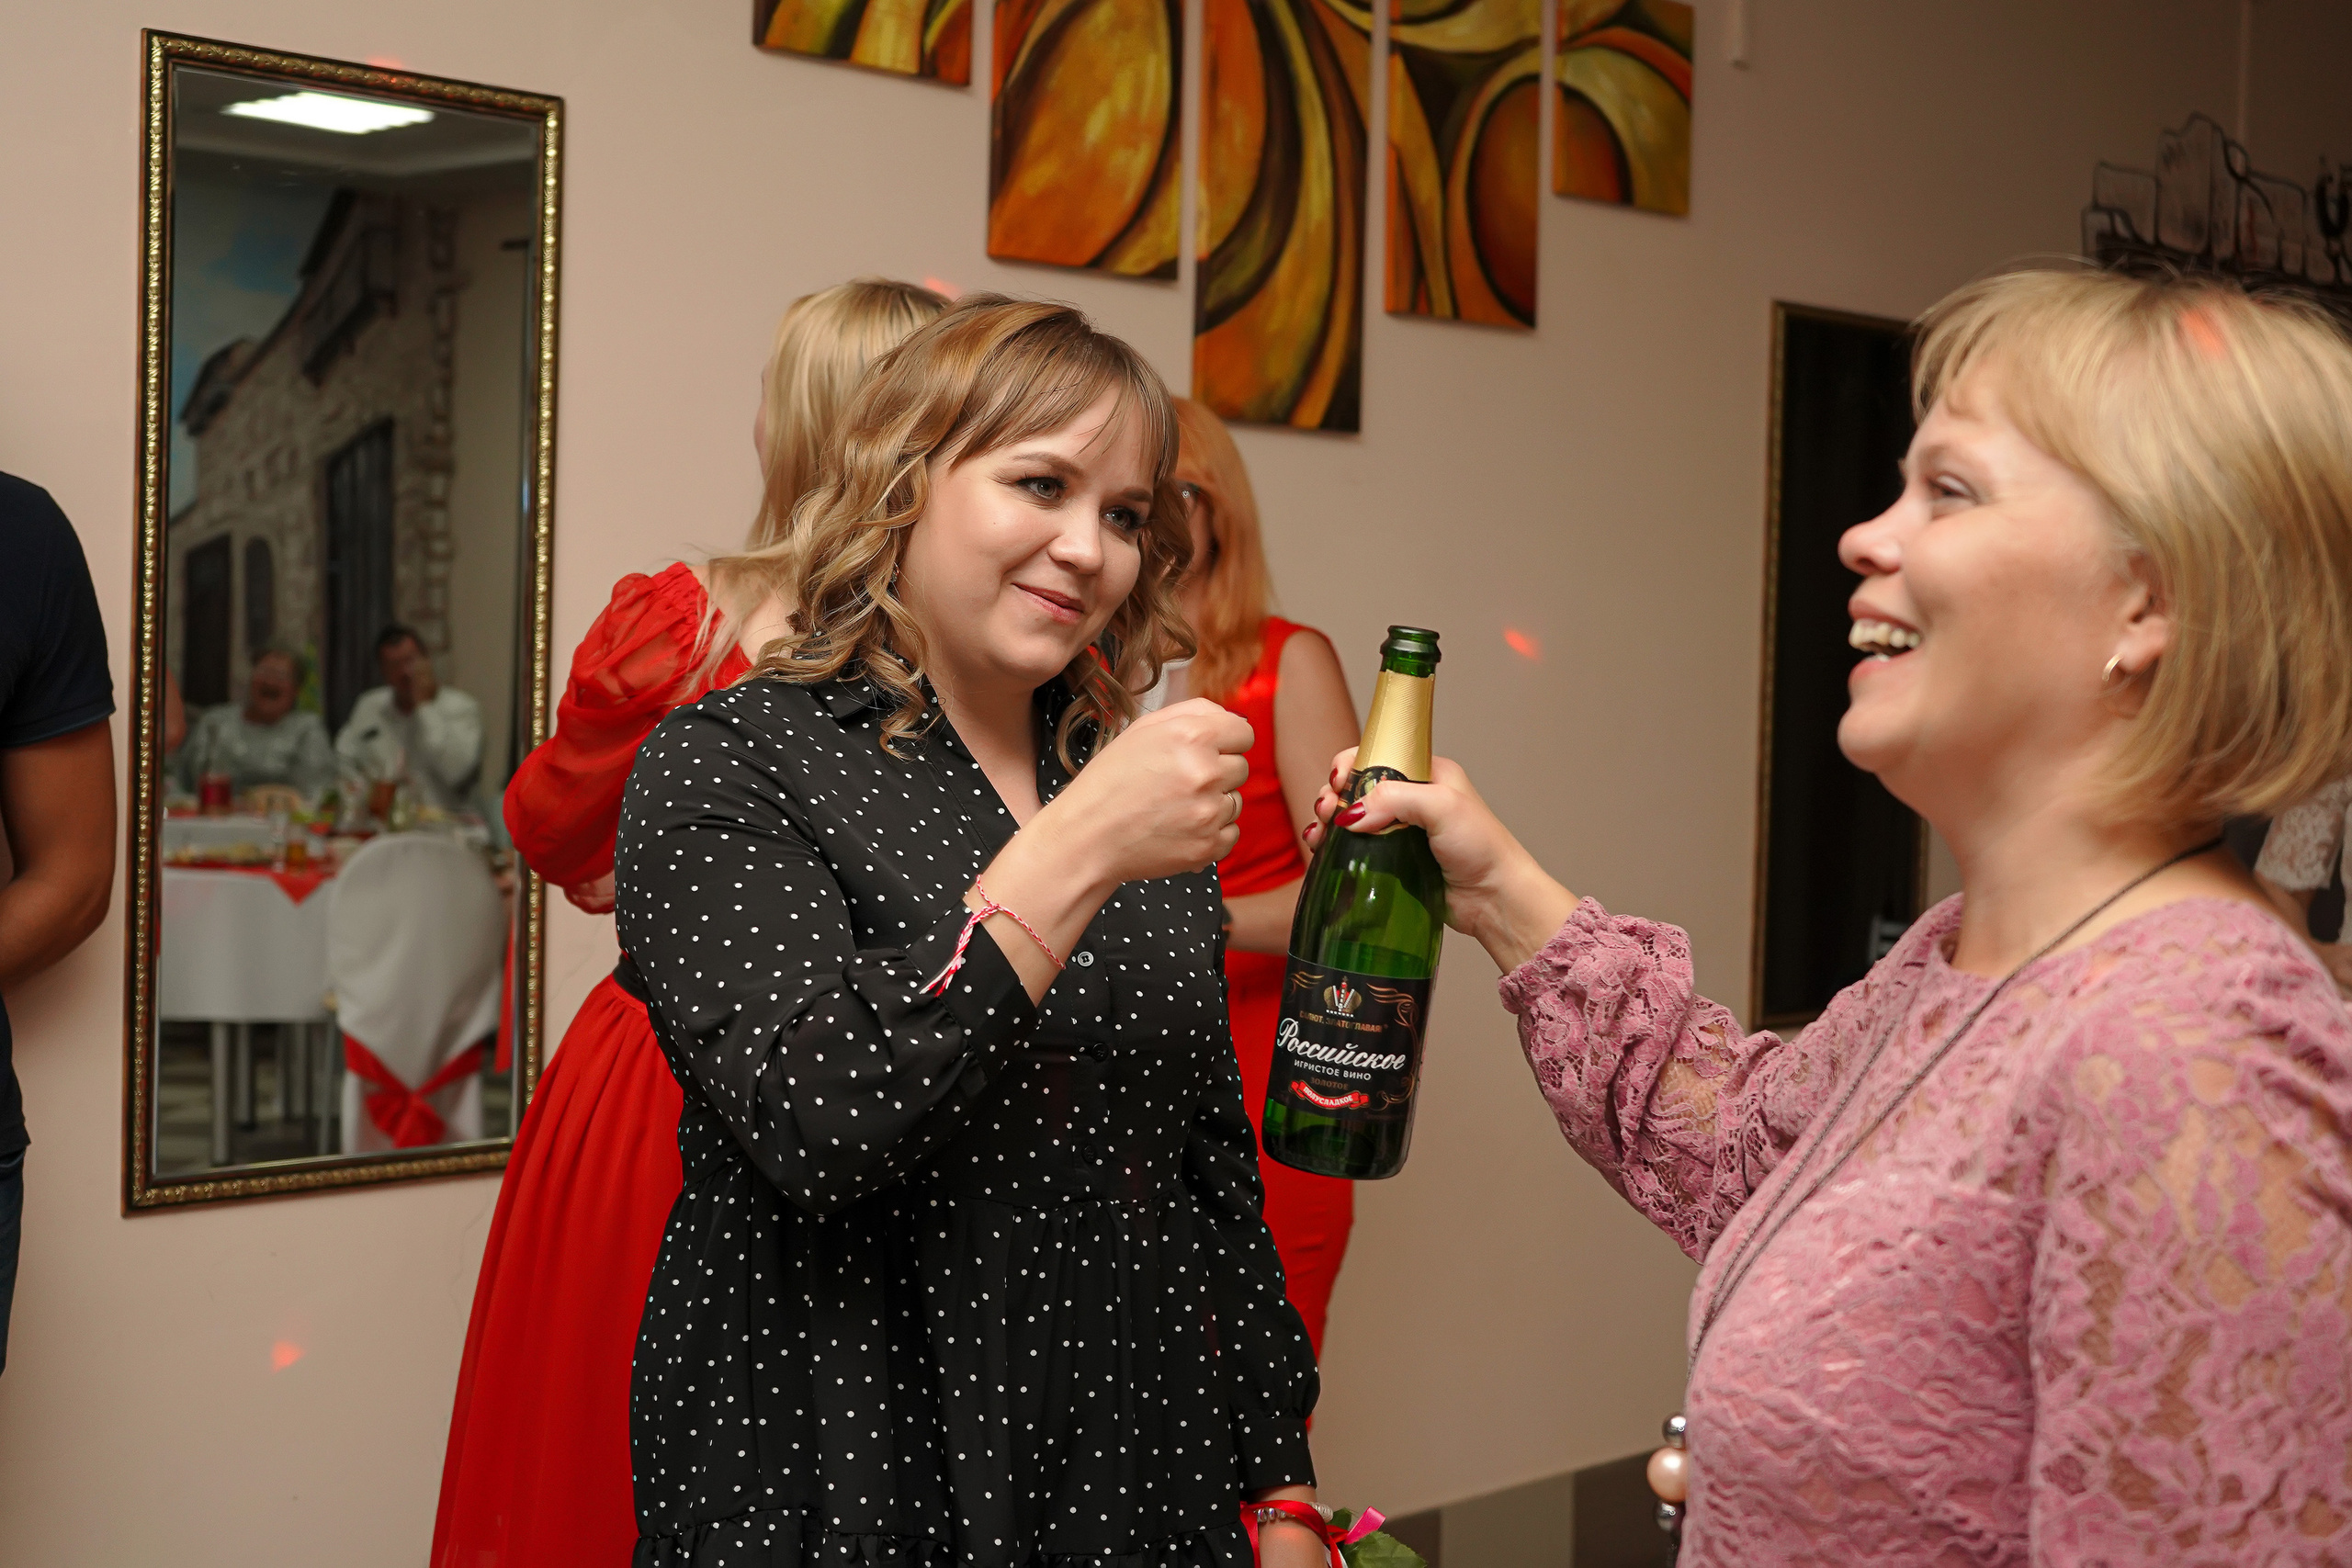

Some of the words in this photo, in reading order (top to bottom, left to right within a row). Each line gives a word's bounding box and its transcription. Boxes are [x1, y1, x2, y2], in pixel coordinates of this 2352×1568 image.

[1276, 1017, 1407, 1070] Российское
[1294, 1059, 1340, 1077] ИГРИСТОЕ
[1343, 1070, 1372, 1081] ВИНО
[1310, 1077, 1349, 1090] ЗОЛОТОЕ
[1303, 1086, 1353, 1106] ПОЛУСЛАДКОЕ
